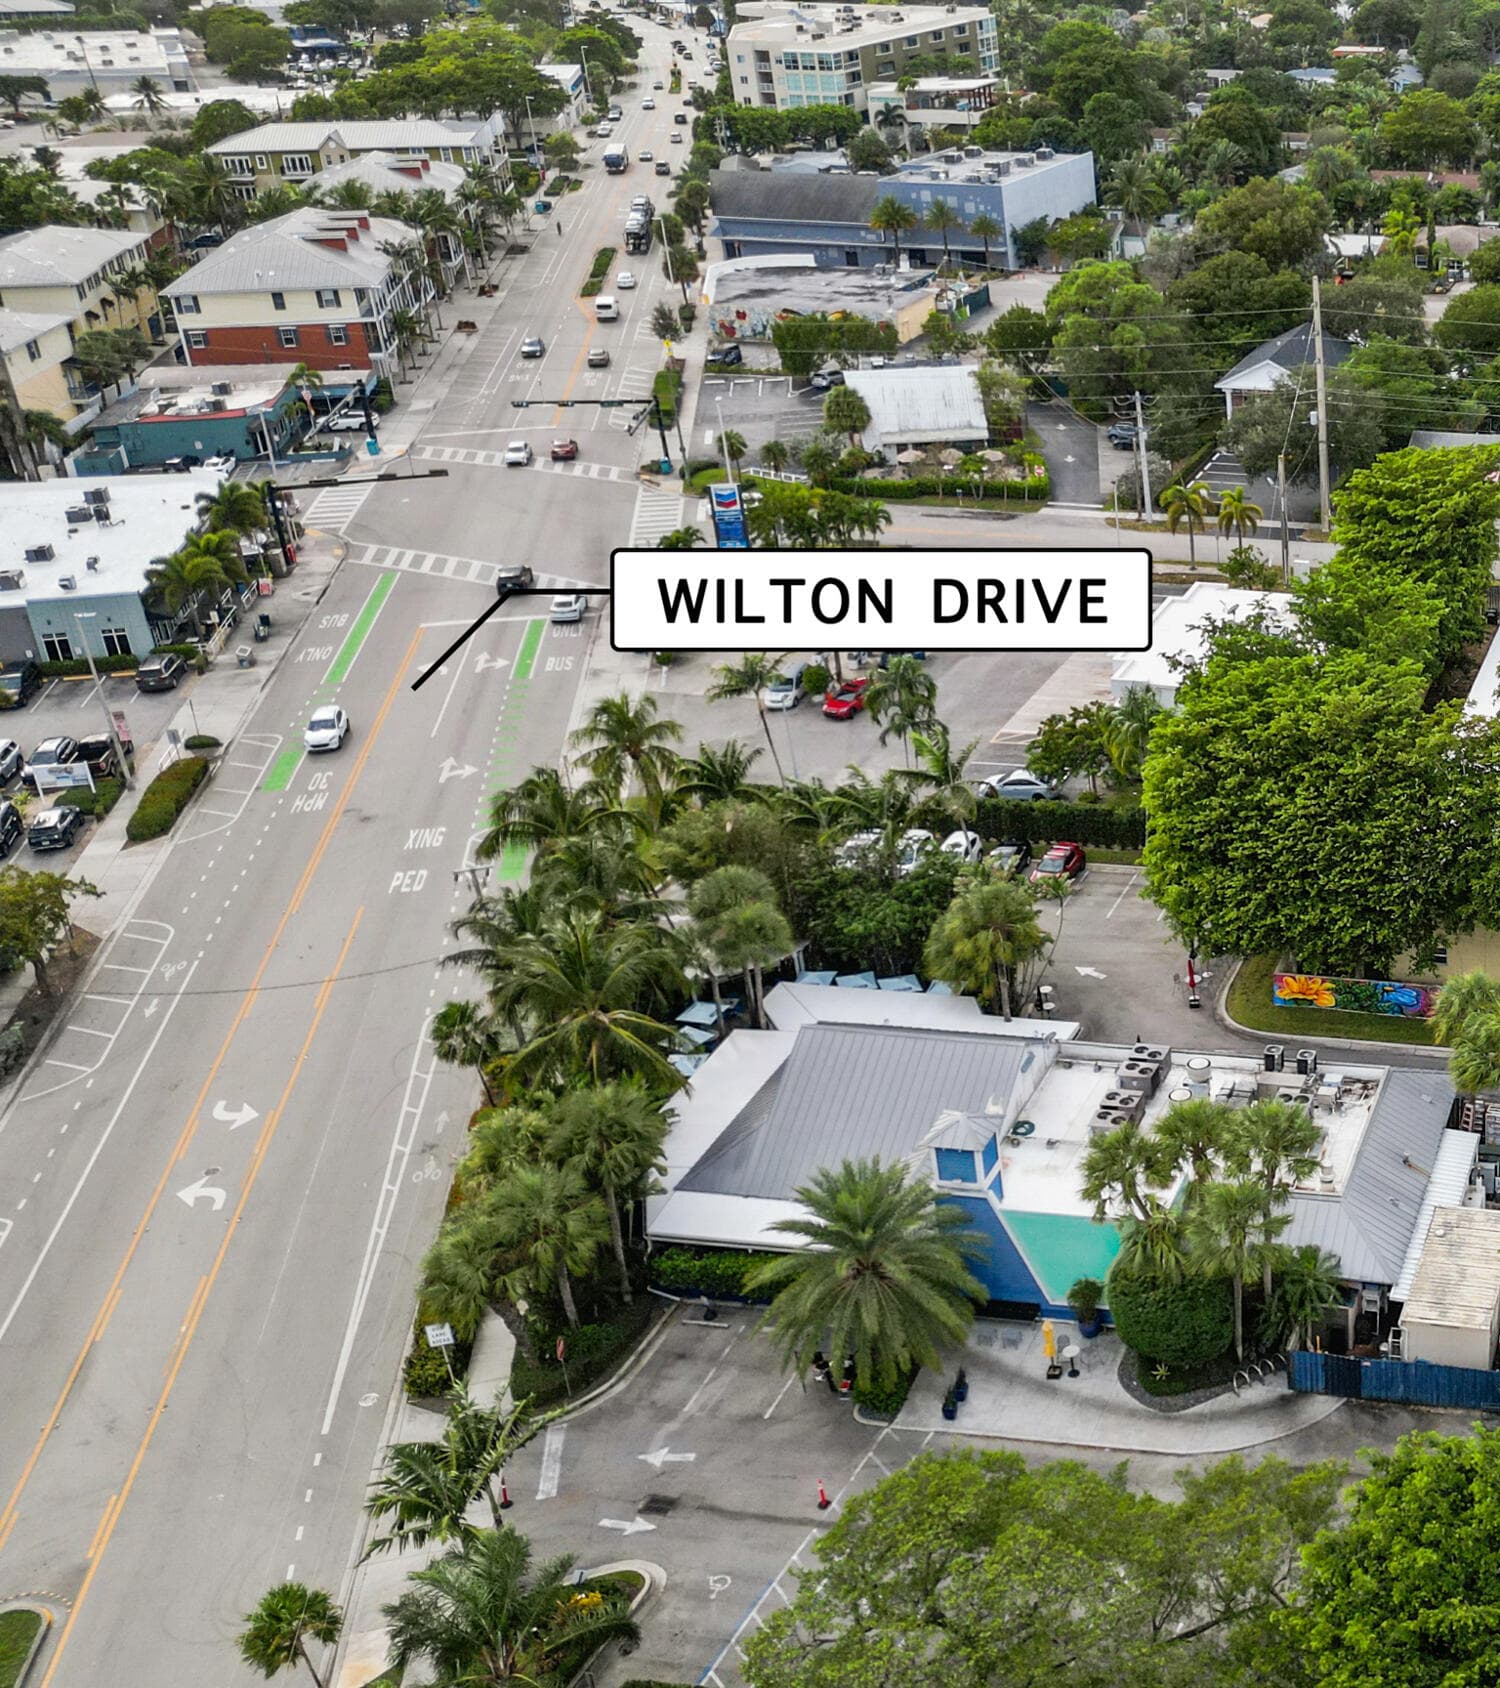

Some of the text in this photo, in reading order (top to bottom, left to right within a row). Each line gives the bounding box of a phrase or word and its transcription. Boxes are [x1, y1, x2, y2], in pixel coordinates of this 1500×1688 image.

[318, 613, 350, 629] BUS
[553, 624, 585, 638] ONLY
[294, 646, 333, 663] ONLY
[544, 656, 575, 671] BUS
[308, 771, 334, 791] 30
[290, 791, 329, 813] MPH
[403, 827, 446, 849] XING
[388, 869, 428, 894] PED
